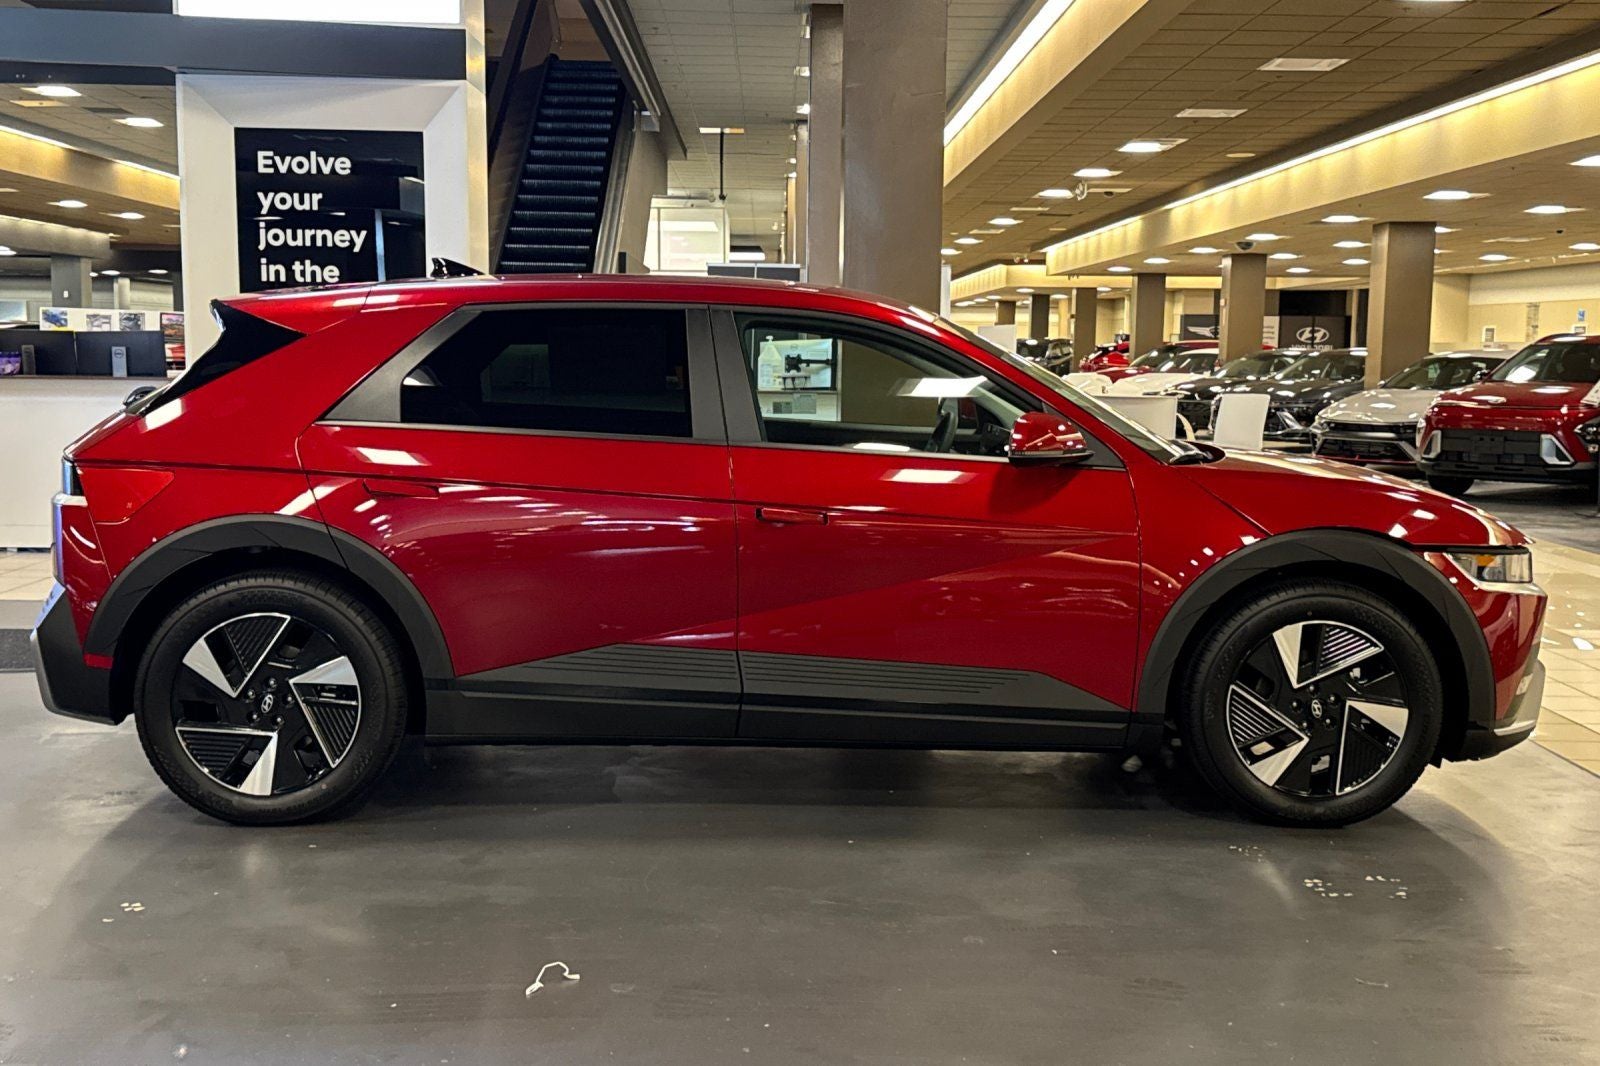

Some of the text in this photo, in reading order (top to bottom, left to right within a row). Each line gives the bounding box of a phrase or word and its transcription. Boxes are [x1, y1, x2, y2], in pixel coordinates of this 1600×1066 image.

[257, 150, 352, 175] Evolve
[256, 191, 323, 215] your
[258, 221, 367, 253] journey
[260, 257, 340, 283] in the
